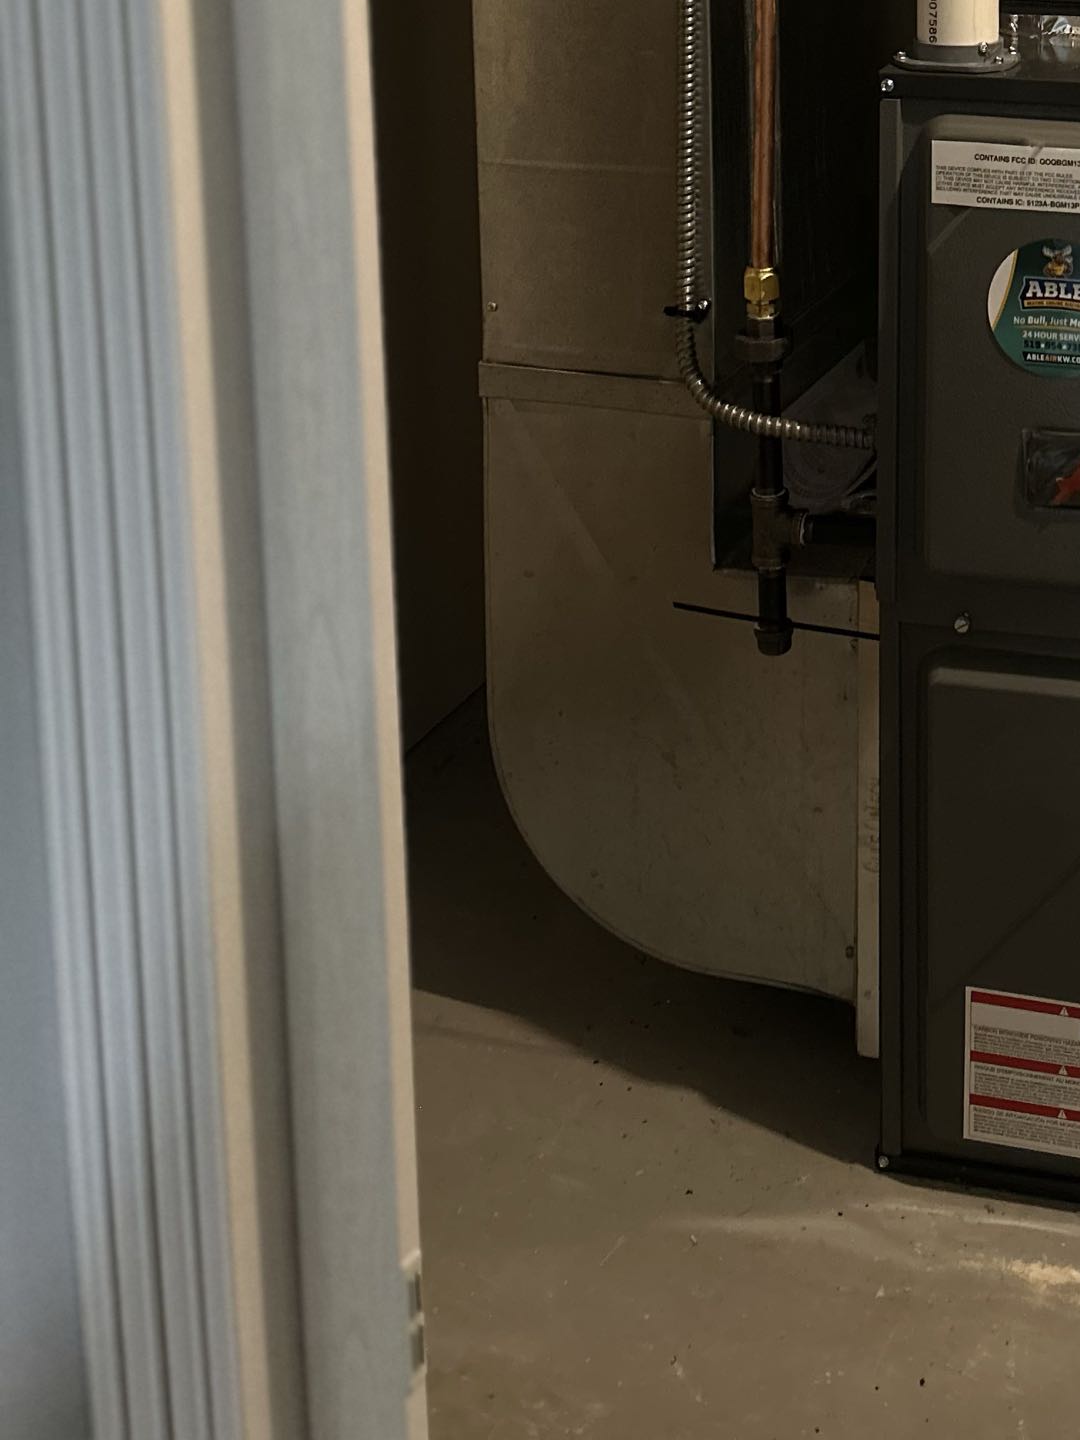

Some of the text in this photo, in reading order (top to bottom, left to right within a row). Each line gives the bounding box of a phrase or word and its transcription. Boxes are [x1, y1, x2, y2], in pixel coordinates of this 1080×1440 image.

[974, 154, 1010, 163] CONTAINS
[1011, 156, 1026, 164] FCC
[976, 196, 1014, 205] CONTAINS
[1013, 316, 1026, 325] No
[1027, 316, 1047, 326] Bull,
[1050, 316, 1068, 326] Just
[1022, 331, 1033, 339] 24
[1034, 331, 1058, 340] HOUR
